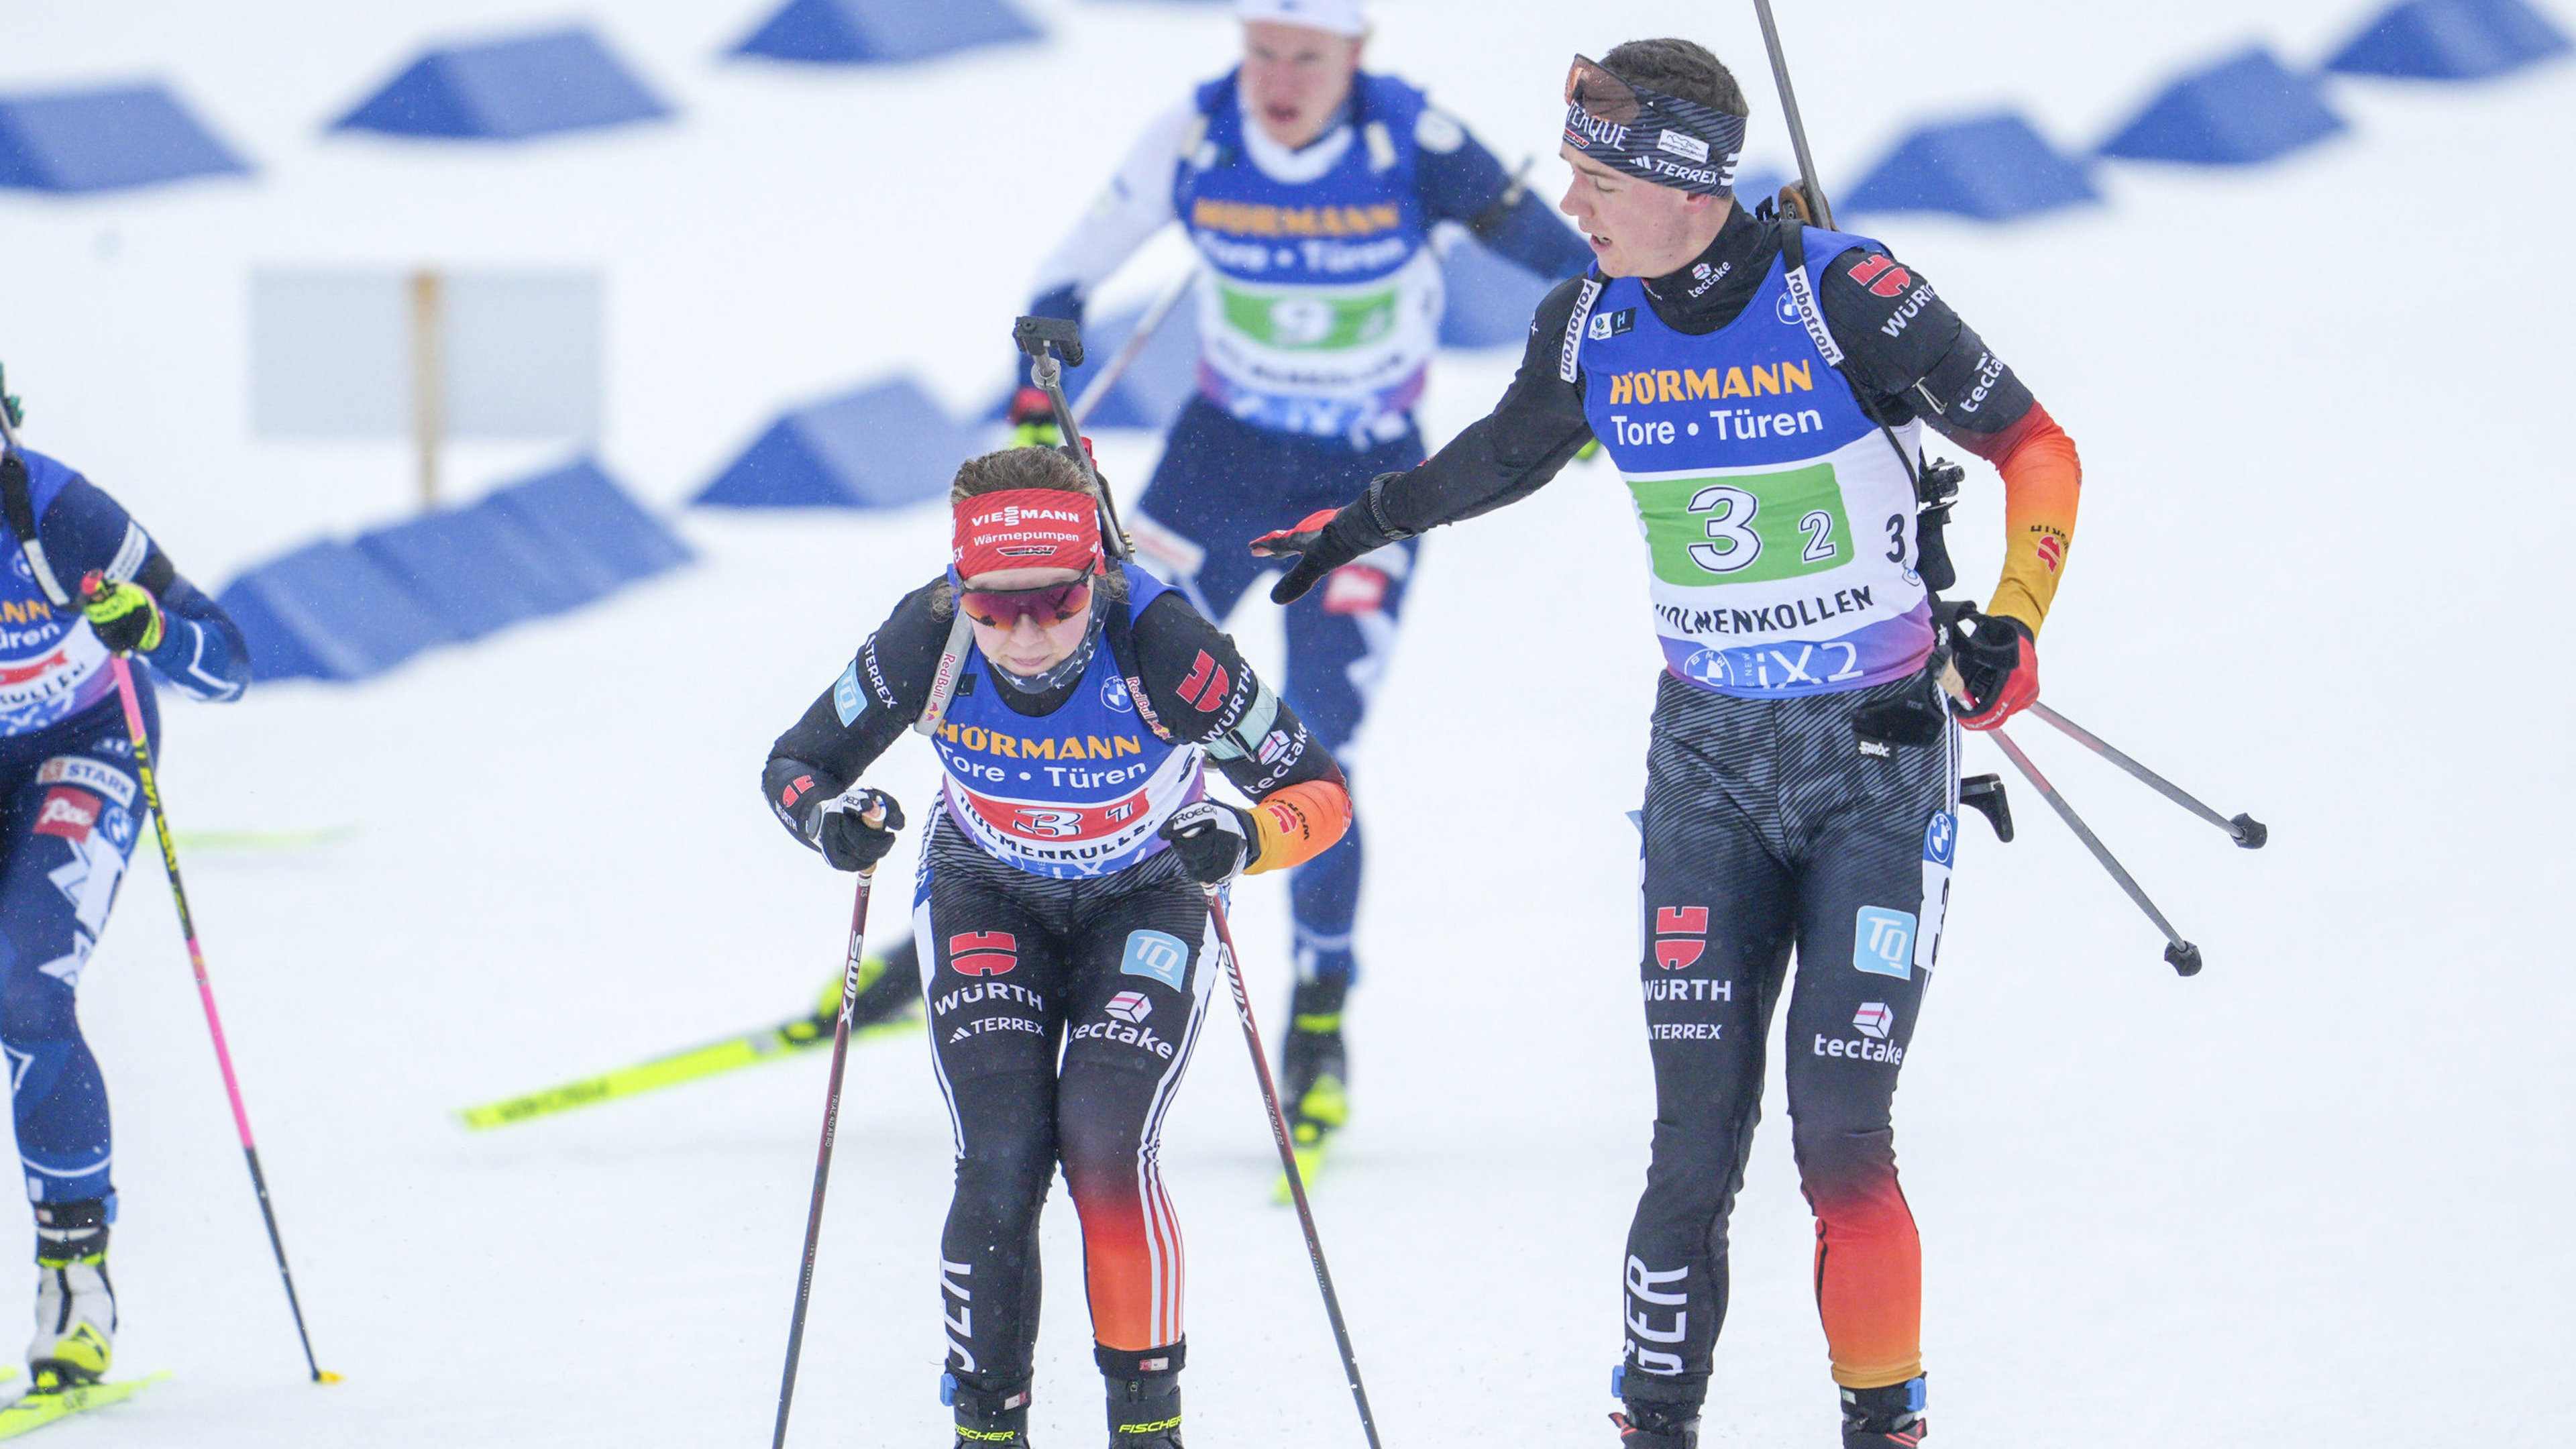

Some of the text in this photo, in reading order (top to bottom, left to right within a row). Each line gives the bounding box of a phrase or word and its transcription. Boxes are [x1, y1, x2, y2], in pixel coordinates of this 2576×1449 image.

[1655, 159, 1717, 184] TERREX
[1688, 261, 1731, 298] tectake
[1562, 283, 1595, 375] robotron
[1789, 274, 1835, 360] robotron
[1610, 359, 1813, 405] HÖRMANN
[1960, 358, 2004, 413] tecta
[1611, 409, 1823, 445] Tore Türen
[974, 531, 1079, 546] Wärmepumpen
[1687, 486, 1835, 574] 3 2
[1886, 513, 1905, 562] 3
[865, 643, 898, 709] TERREX
[1690, 651, 1727, 667] BMW
[1201, 663, 1252, 743] WÜRTH
[936, 720, 1141, 760] HÖRMANN
[1244, 722, 1308, 794] tectake
[936, 740, 1006, 782] Tore
[1044, 762, 1147, 789] Türen
[1013, 809, 1083, 838] 3
[1137, 936, 1179, 981] TQ
[1868, 916, 1909, 970] TQ
[935, 981, 1042, 1016] WÜRTH
[1642, 979, 1731, 1002] WÜRTH
[970, 1017, 1045, 1037] TERREX
[1653, 1024, 1722, 1040] TERREX
[1815, 1033, 1902, 1065] tectake
[1622, 1254, 1688, 1377] GER
[955, 1424, 1016, 1441] FISCHER
[1118, 1415, 1181, 1434] FISCHER
